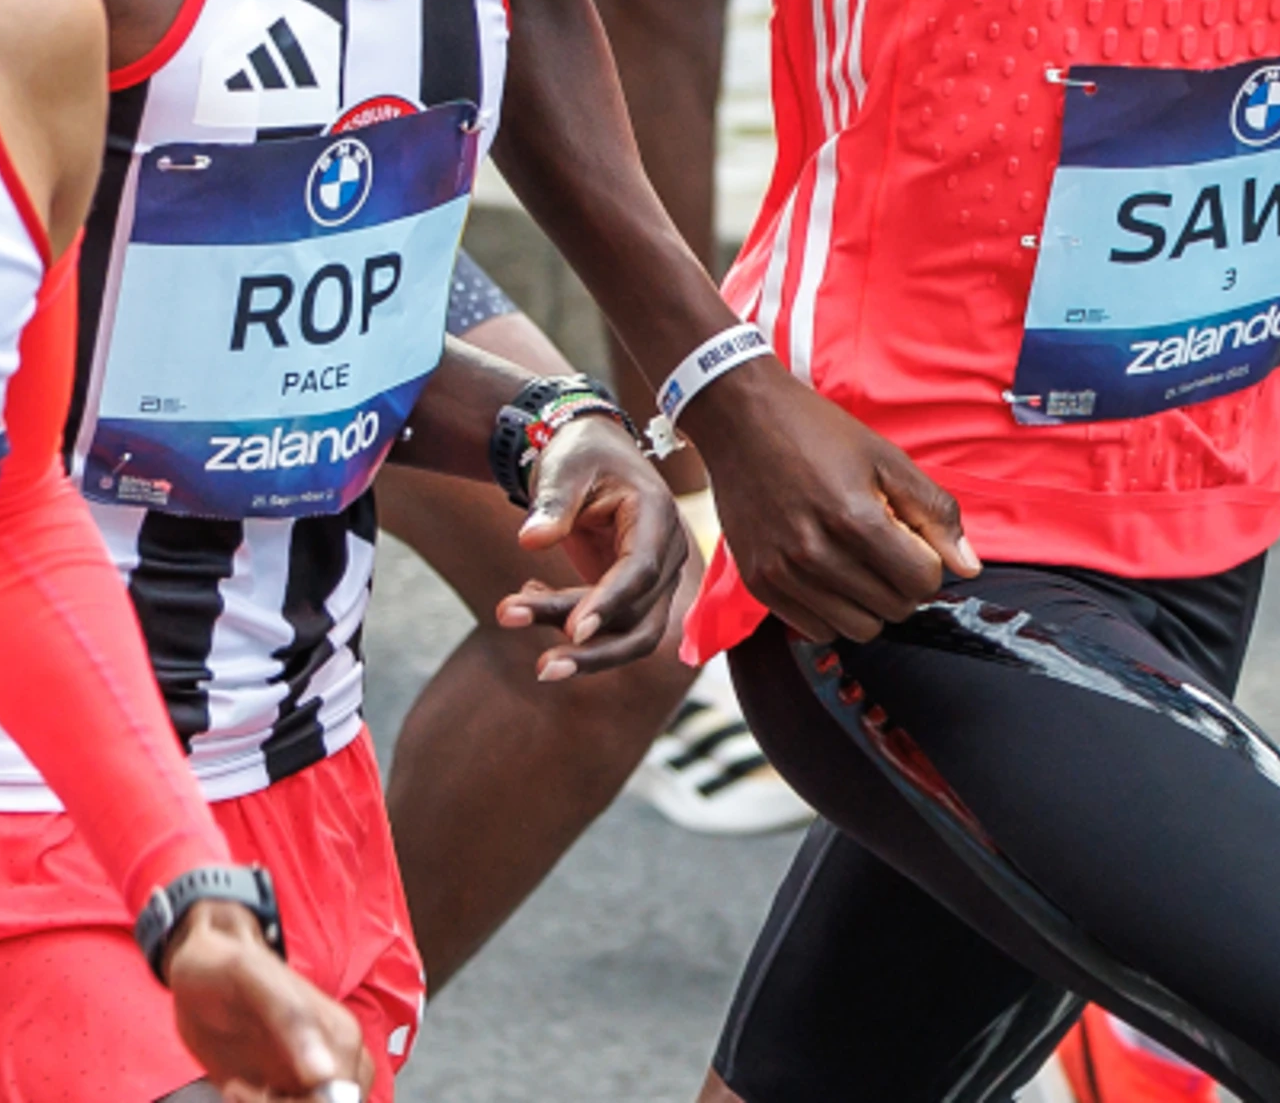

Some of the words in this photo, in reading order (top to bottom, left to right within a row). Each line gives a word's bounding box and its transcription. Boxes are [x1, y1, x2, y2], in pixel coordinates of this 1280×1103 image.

[229, 251, 402, 351] ROP
[1221, 267, 1237, 291] 3
[282, 363, 350, 396] PACE
[204, 411, 379, 472] zalando
